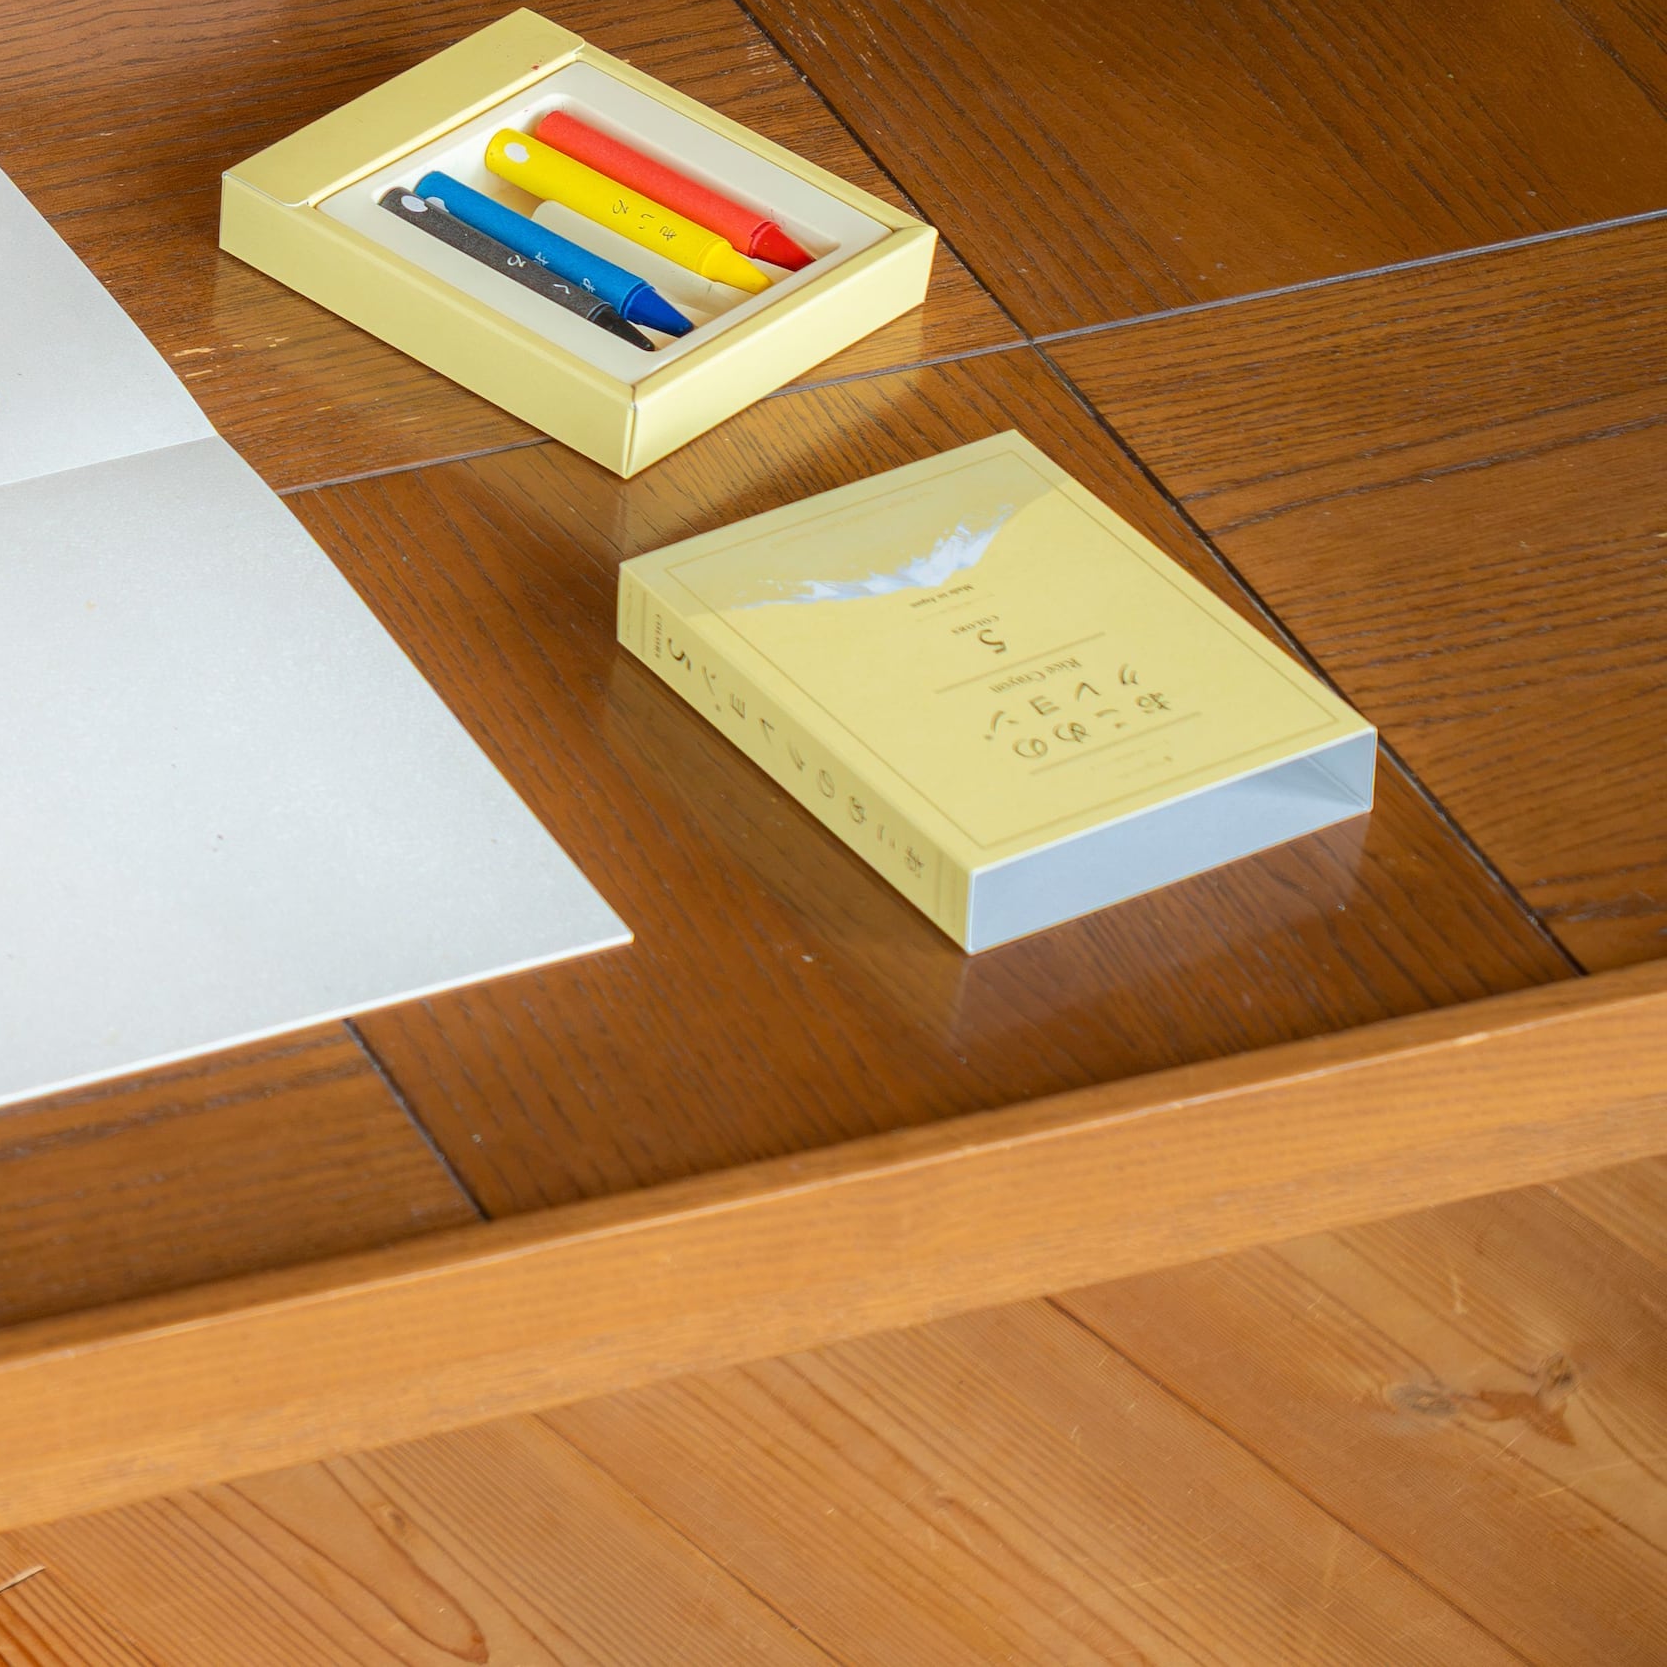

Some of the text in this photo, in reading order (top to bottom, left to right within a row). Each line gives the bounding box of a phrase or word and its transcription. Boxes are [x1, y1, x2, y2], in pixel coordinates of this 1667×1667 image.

[612, 199, 677, 241] きいろ
[507, 254, 570, 294] くろ
[667, 637, 692, 672] 5
[977, 629, 1007, 655] 5
[1011, 691, 1172, 759] おこめの
